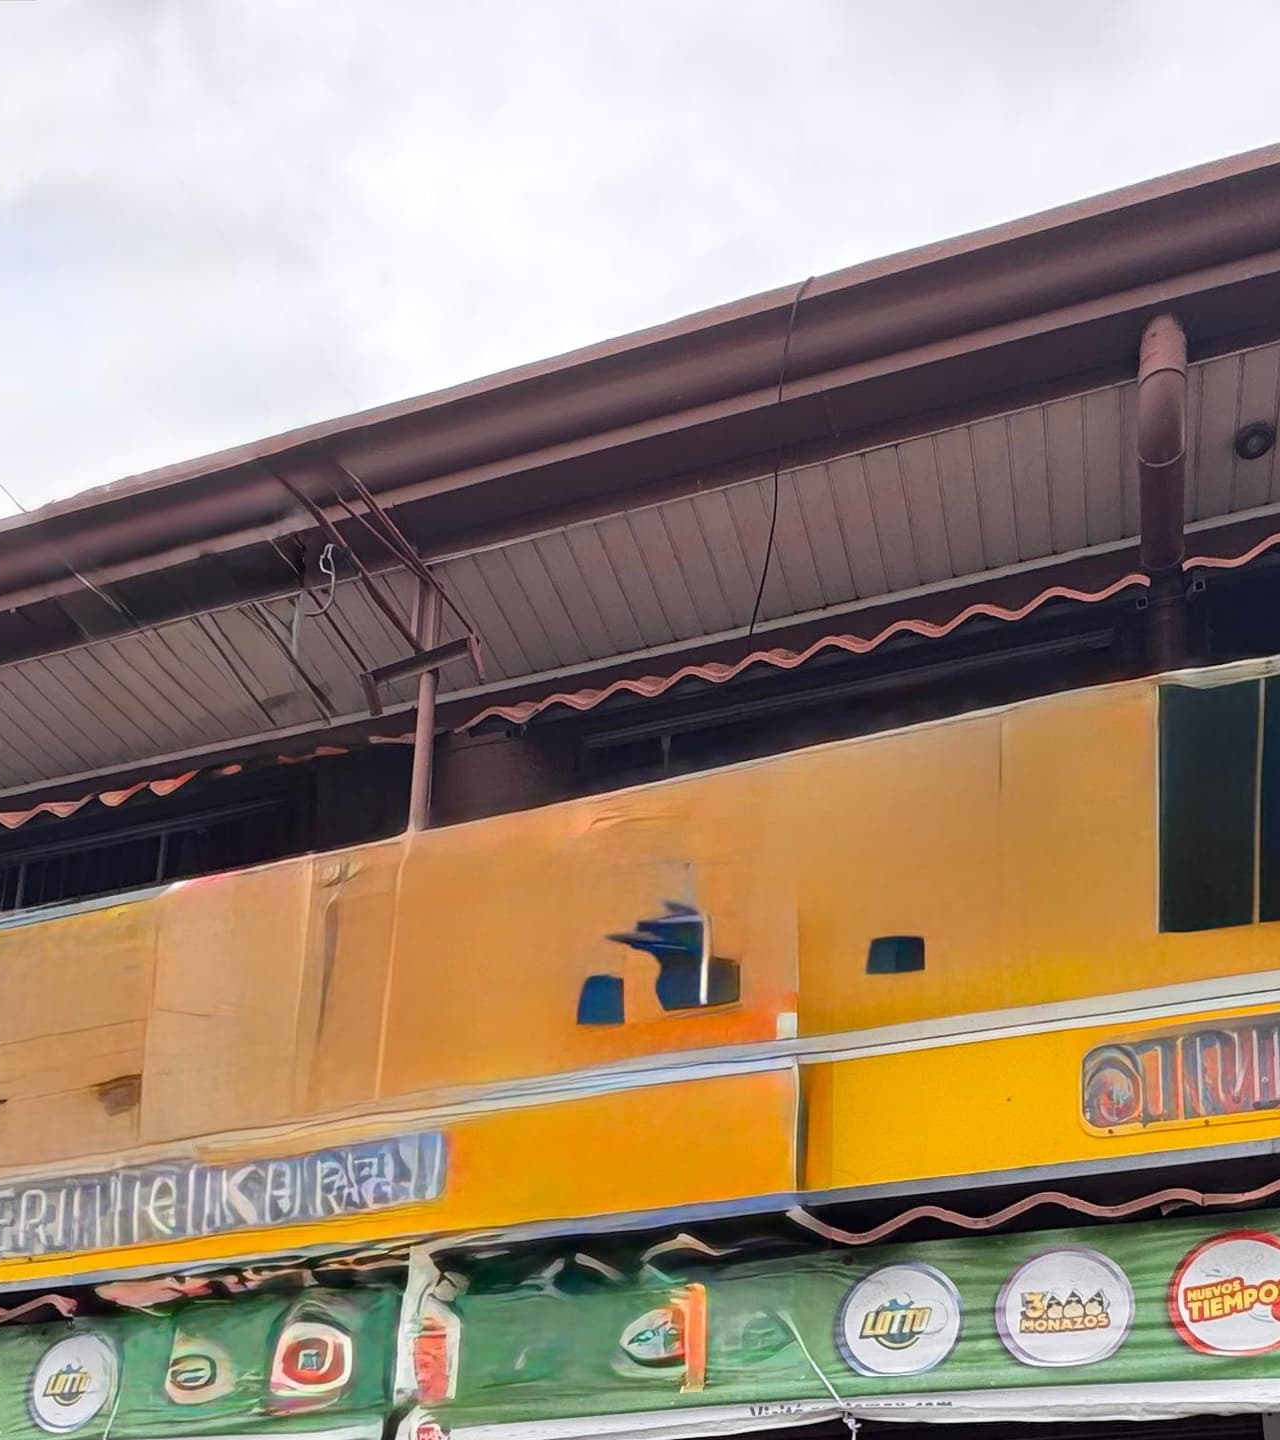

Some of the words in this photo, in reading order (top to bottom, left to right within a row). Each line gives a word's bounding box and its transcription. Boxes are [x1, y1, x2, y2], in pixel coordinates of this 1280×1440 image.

[1186, 1278, 1243, 1302] NUEVOS
[1021, 1291, 1047, 1319] 3
[859, 1304, 932, 1338] LOTTO
[1020, 1313, 1111, 1333] MONAZOS
